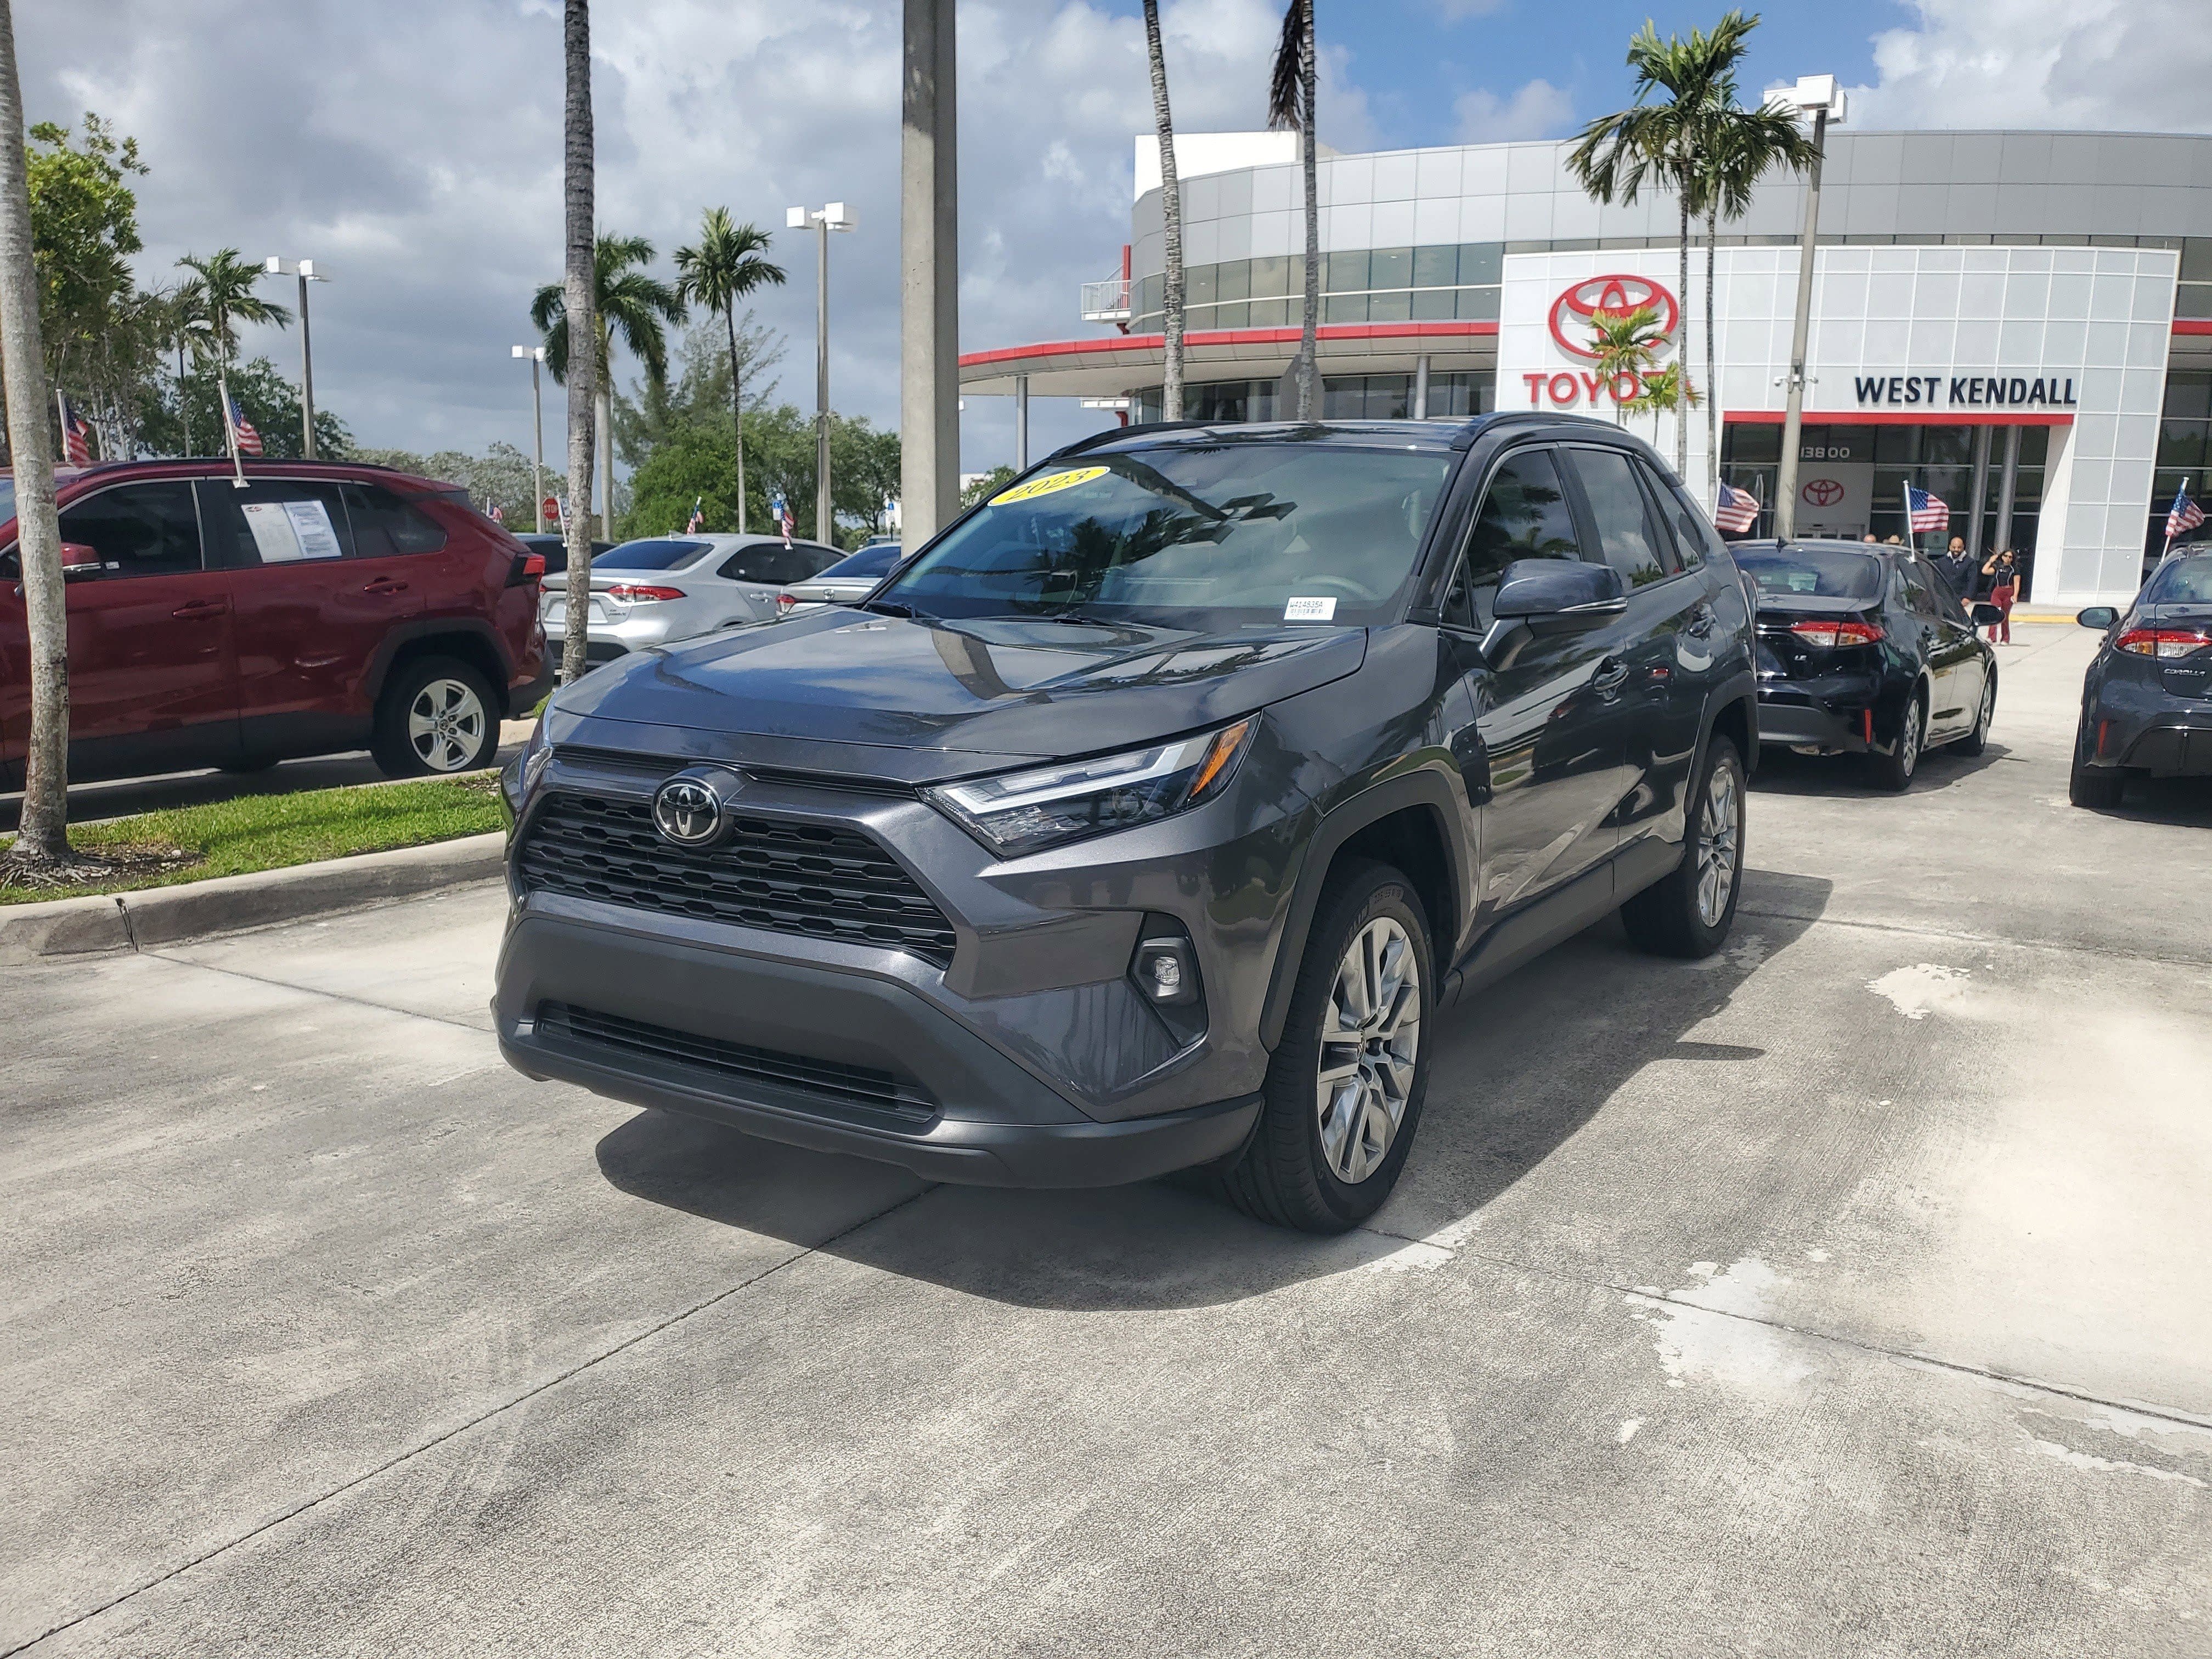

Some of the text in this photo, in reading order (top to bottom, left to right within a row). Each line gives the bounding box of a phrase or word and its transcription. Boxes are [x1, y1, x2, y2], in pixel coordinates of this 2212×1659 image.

[1855, 377, 2077, 404] WEST KENDALL
[1800, 447, 1850, 458] 13800
[1005, 470, 1091, 501] 2023
